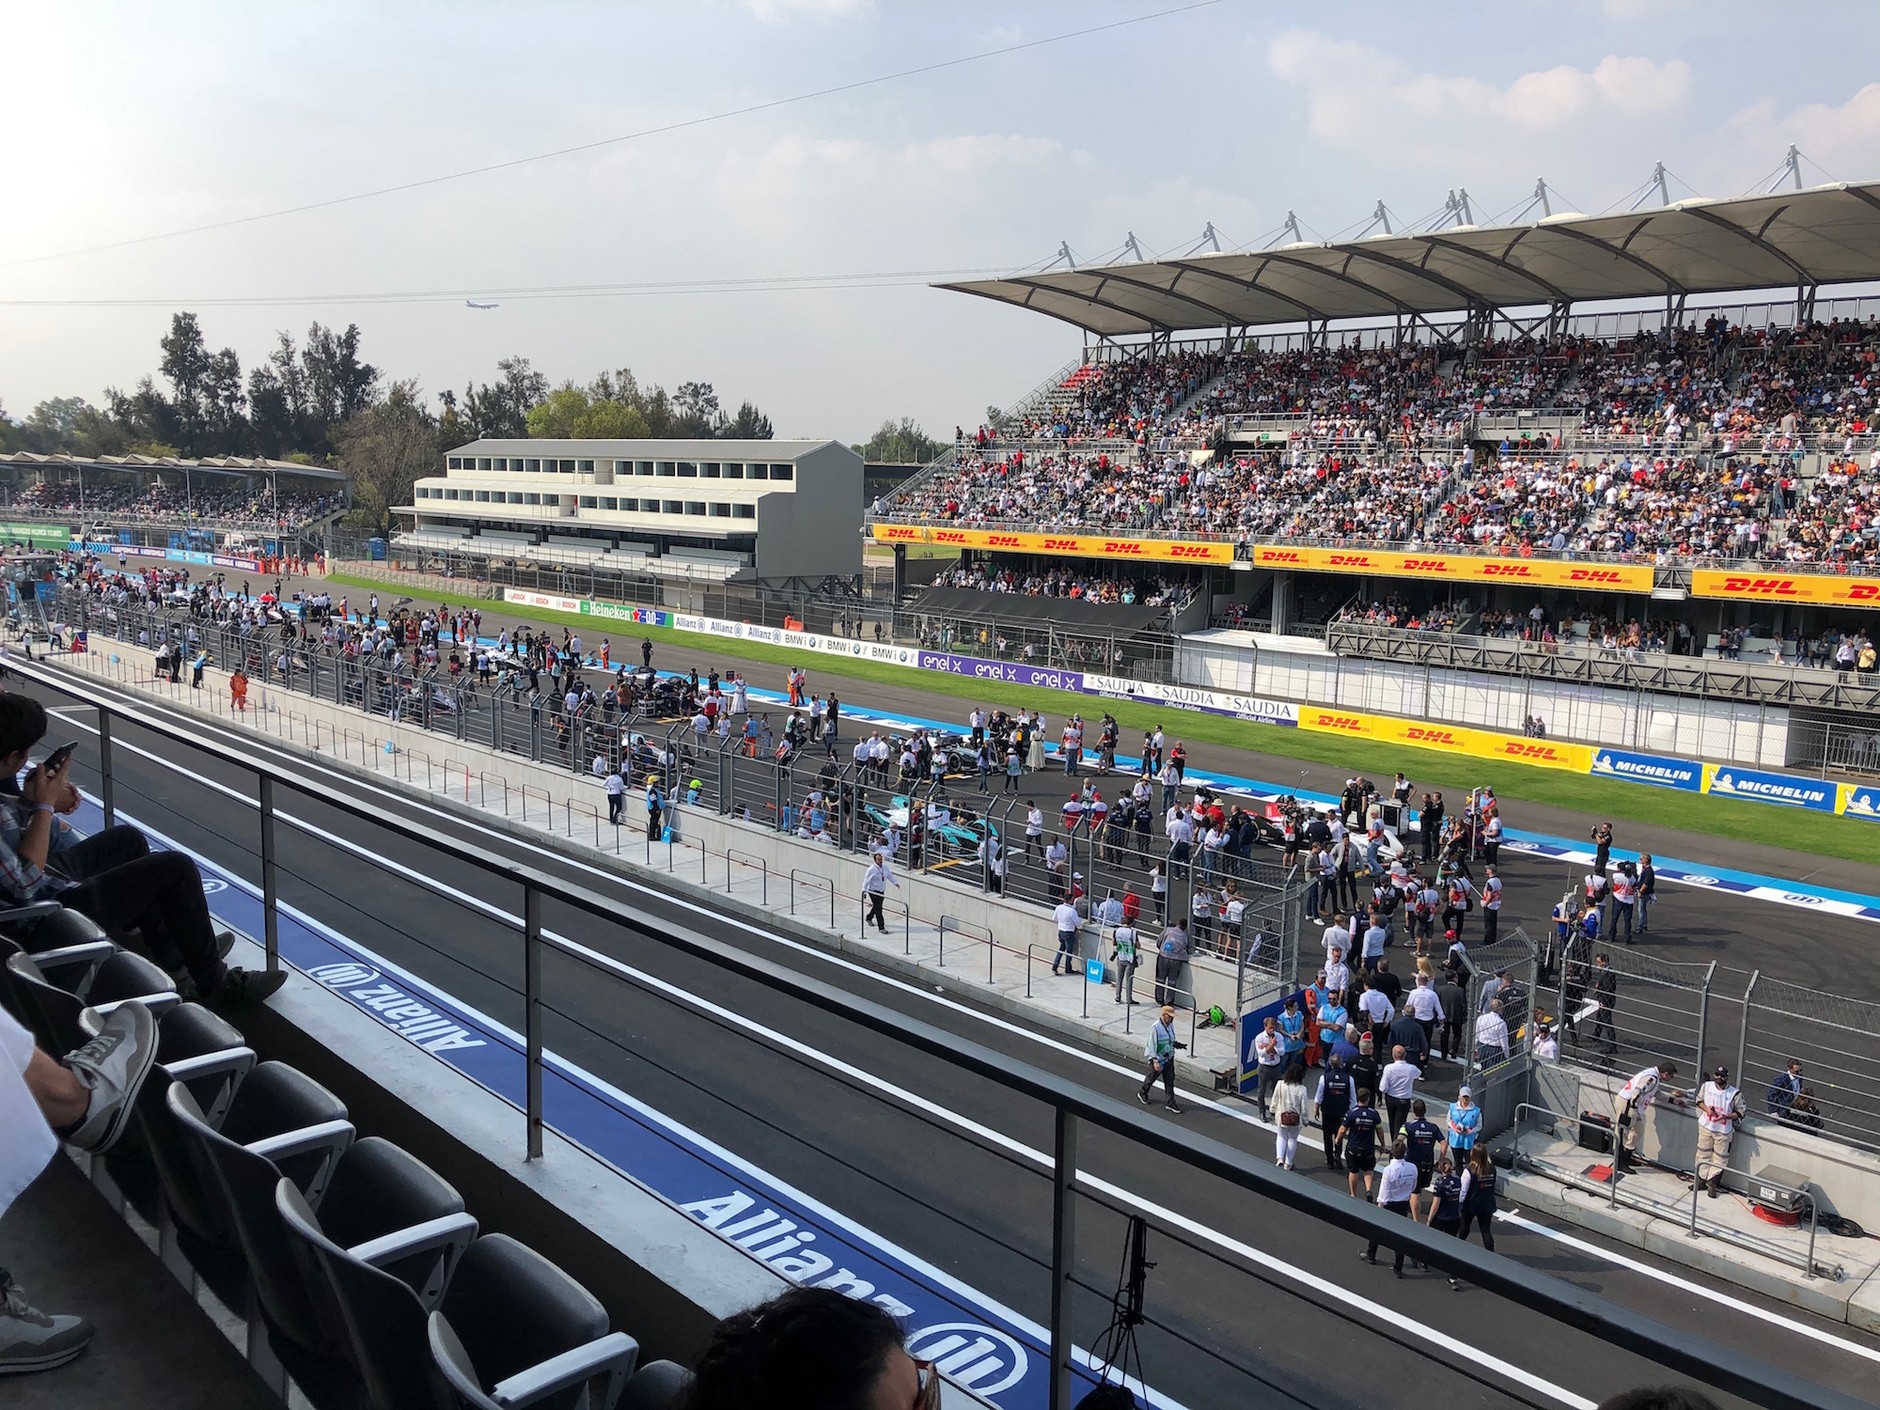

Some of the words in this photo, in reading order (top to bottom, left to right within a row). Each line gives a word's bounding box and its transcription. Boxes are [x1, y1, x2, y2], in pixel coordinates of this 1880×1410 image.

[888, 529, 915, 538] DHL
[936, 532, 966, 543] DHL
[988, 536, 1020, 547] DHL
[1044, 540, 1078, 550] DHL
[1105, 543, 1142, 554] DHL
[1170, 546, 1211, 558] DHL
[1262, 551, 1300, 562] DHL
[1329, 556, 1370, 567] DHL
[1403, 560, 1447, 572] DHL
[1483, 565, 1531, 577] DHL
[1569, 570, 1622, 583] DHL
[1723, 578, 1798, 595] DHL
[562, 601, 577, 609] BOSCH
[590, 602, 630, 621] Heineken
[676, 617, 697, 629] Allianz
[711, 622, 733, 634] Allianz
[748, 627, 771, 640] Allianz
[785, 634, 803, 646] BMW
[827, 640, 847, 652] BMW
[872, 647, 893, 660] BMW
[923, 655, 950, 671] enel
[975, 664, 1004, 680] enel
[1031, 671, 1062, 688] enel
[1096, 676, 1145, 695] SAUDIA
[1162, 686, 1215, 706] SAUDIA
[1233, 697, 1292, 718] SAUDIA
[1318, 715, 1361, 731] DHL
[1407, 728, 1455, 745] DHL
[1504, 742, 1558, 760] DHL
[1615, 760, 1692, 781] MICHELIN
[1736, 780, 1825, 802] MICHELIN
[349, 984, 487, 1052] Allianz
